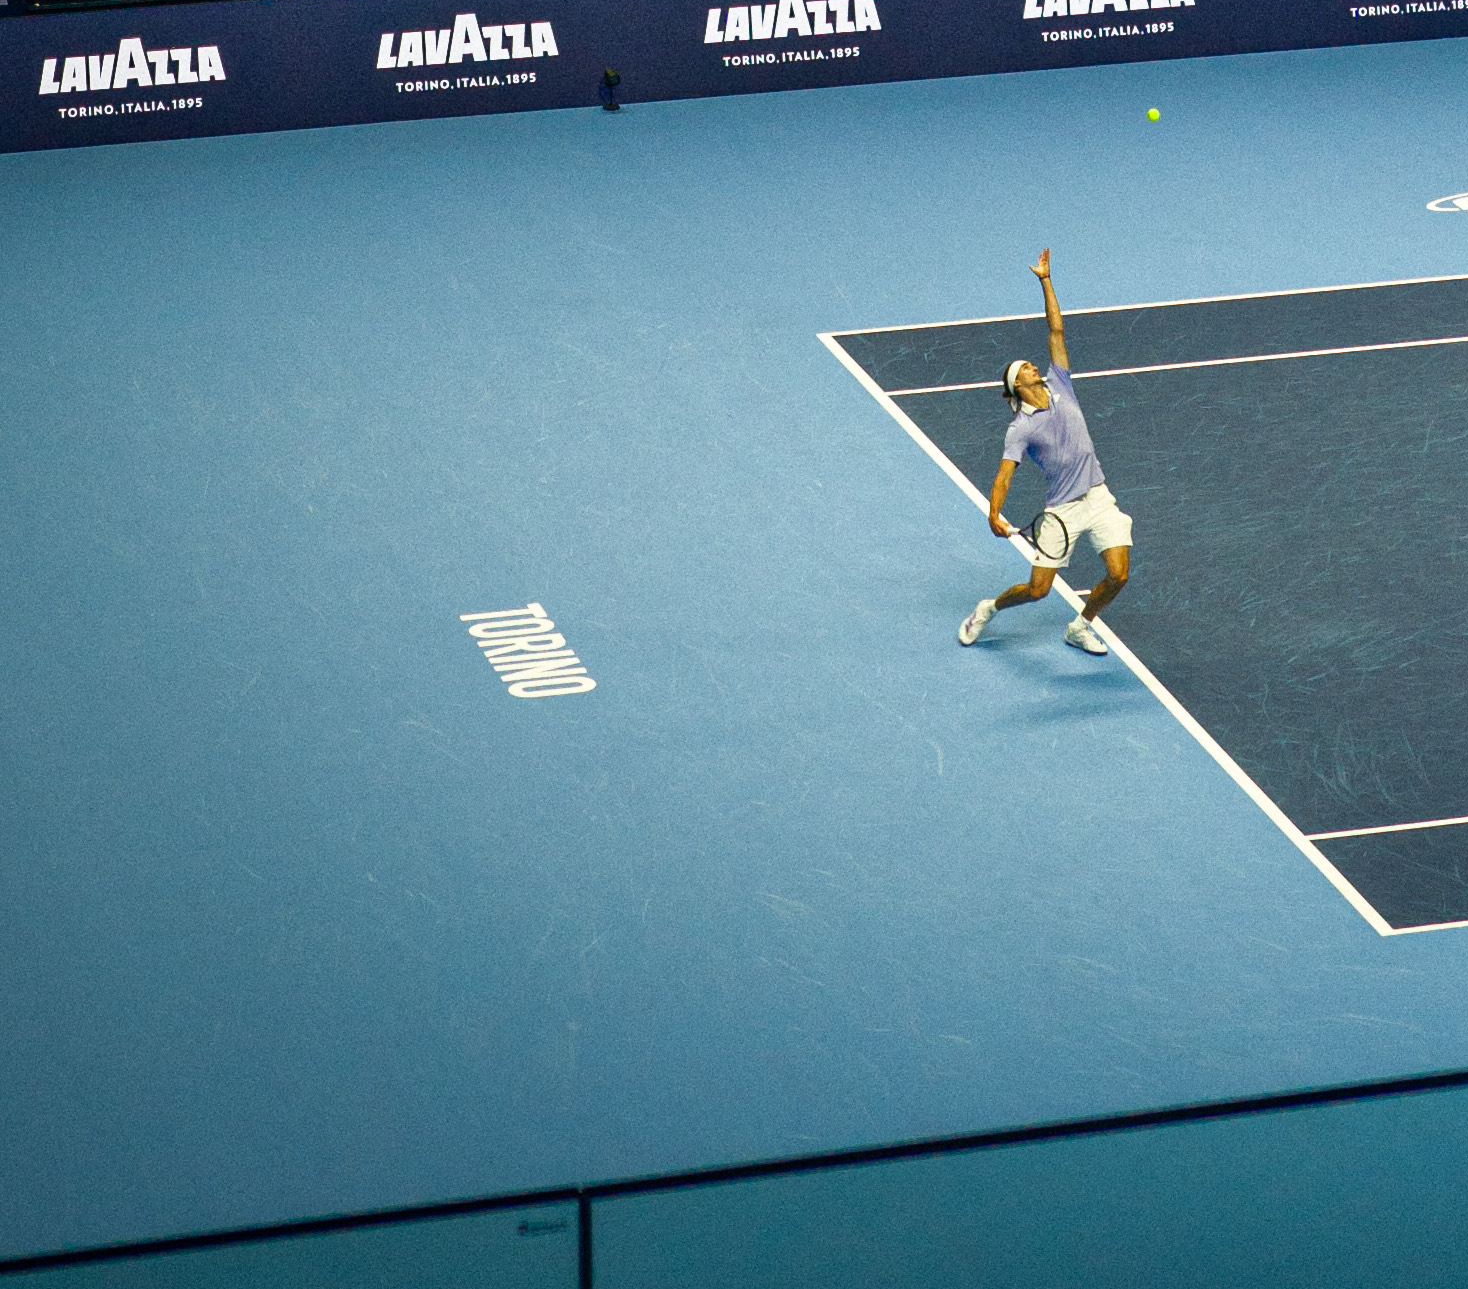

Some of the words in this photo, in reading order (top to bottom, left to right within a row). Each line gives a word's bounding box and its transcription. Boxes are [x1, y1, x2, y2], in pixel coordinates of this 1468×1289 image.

[38, 37, 227, 95] LAVAZZA
[376, 13, 559, 69] LAVAZZA
[459, 602, 597, 698] TORINO
